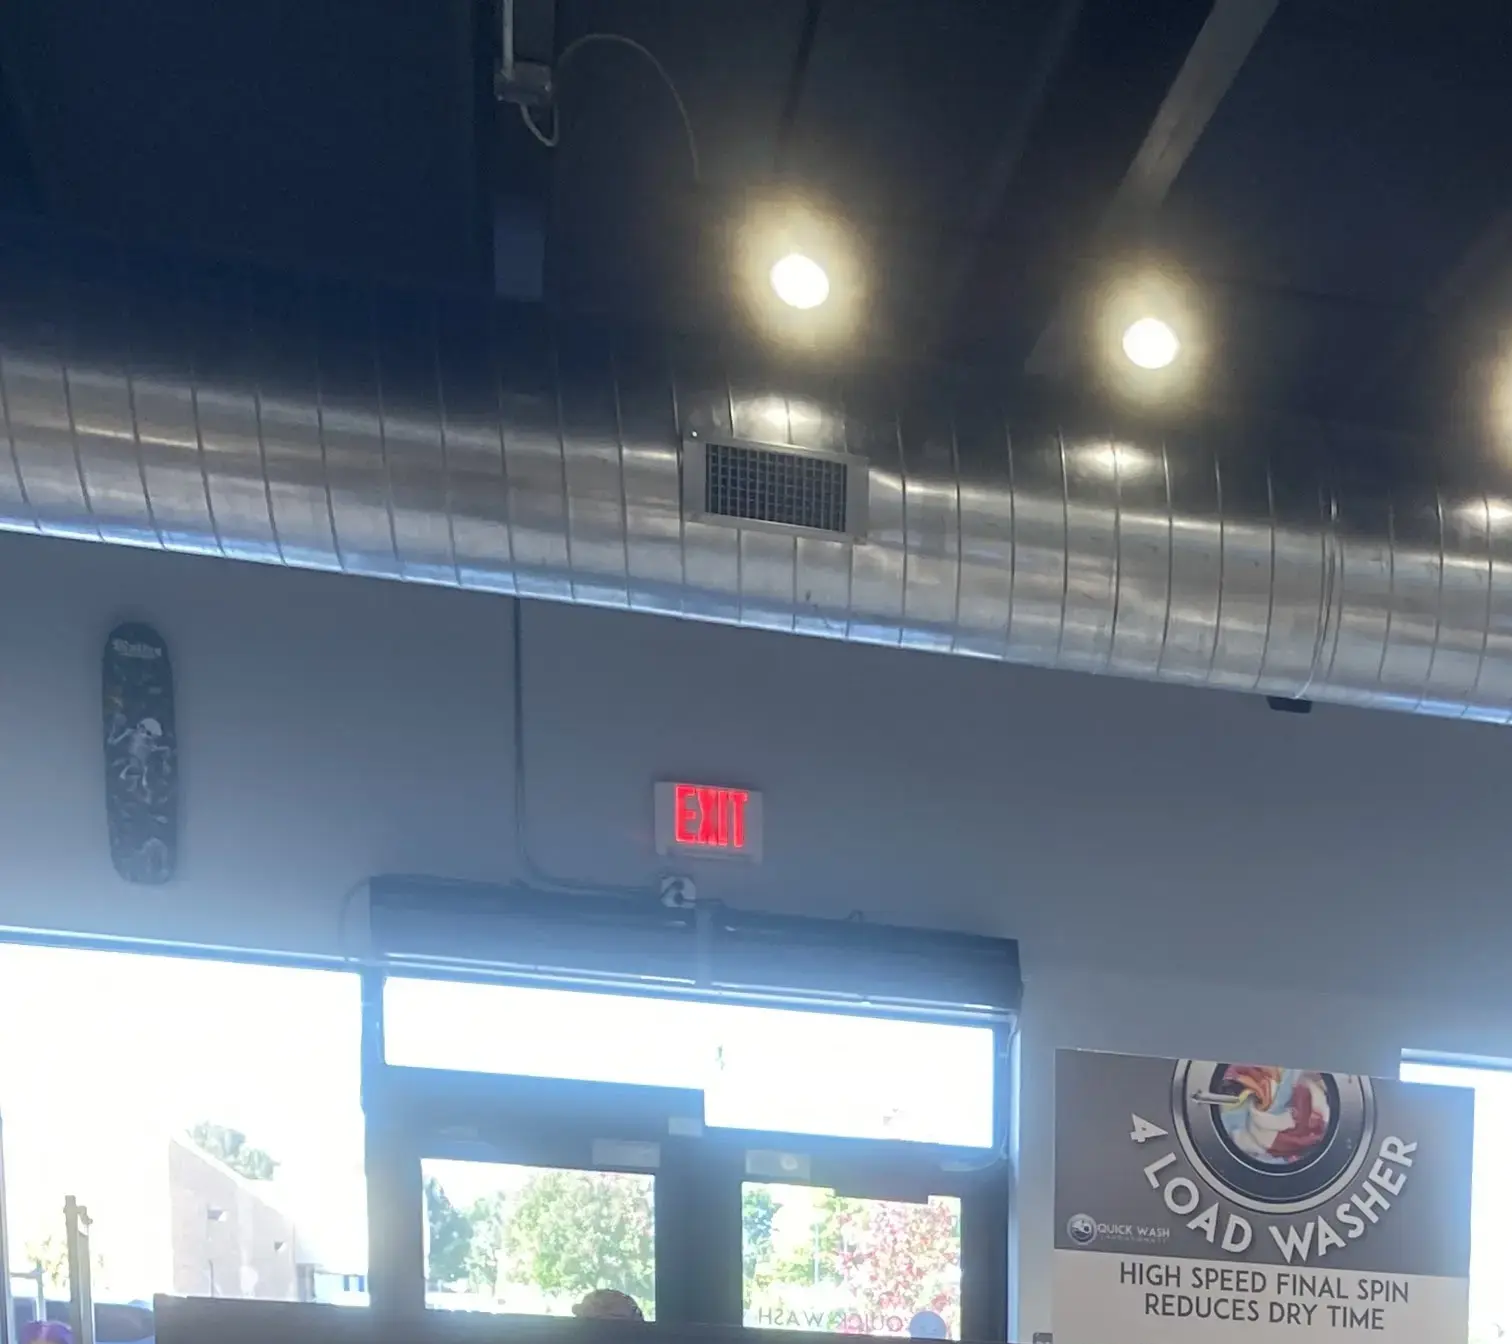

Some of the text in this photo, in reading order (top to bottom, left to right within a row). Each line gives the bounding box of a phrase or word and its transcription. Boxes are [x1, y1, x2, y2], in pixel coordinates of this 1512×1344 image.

[675, 784, 748, 848] EXIT
[1129, 1112, 1419, 1264] 4 LOAD WASHER
[1097, 1223, 1171, 1239] QUICK WASH
[1119, 1261, 1409, 1303] HIGH SPEED FINAL SPIN
[1144, 1293, 1386, 1331] REDUCES DRY TIME
